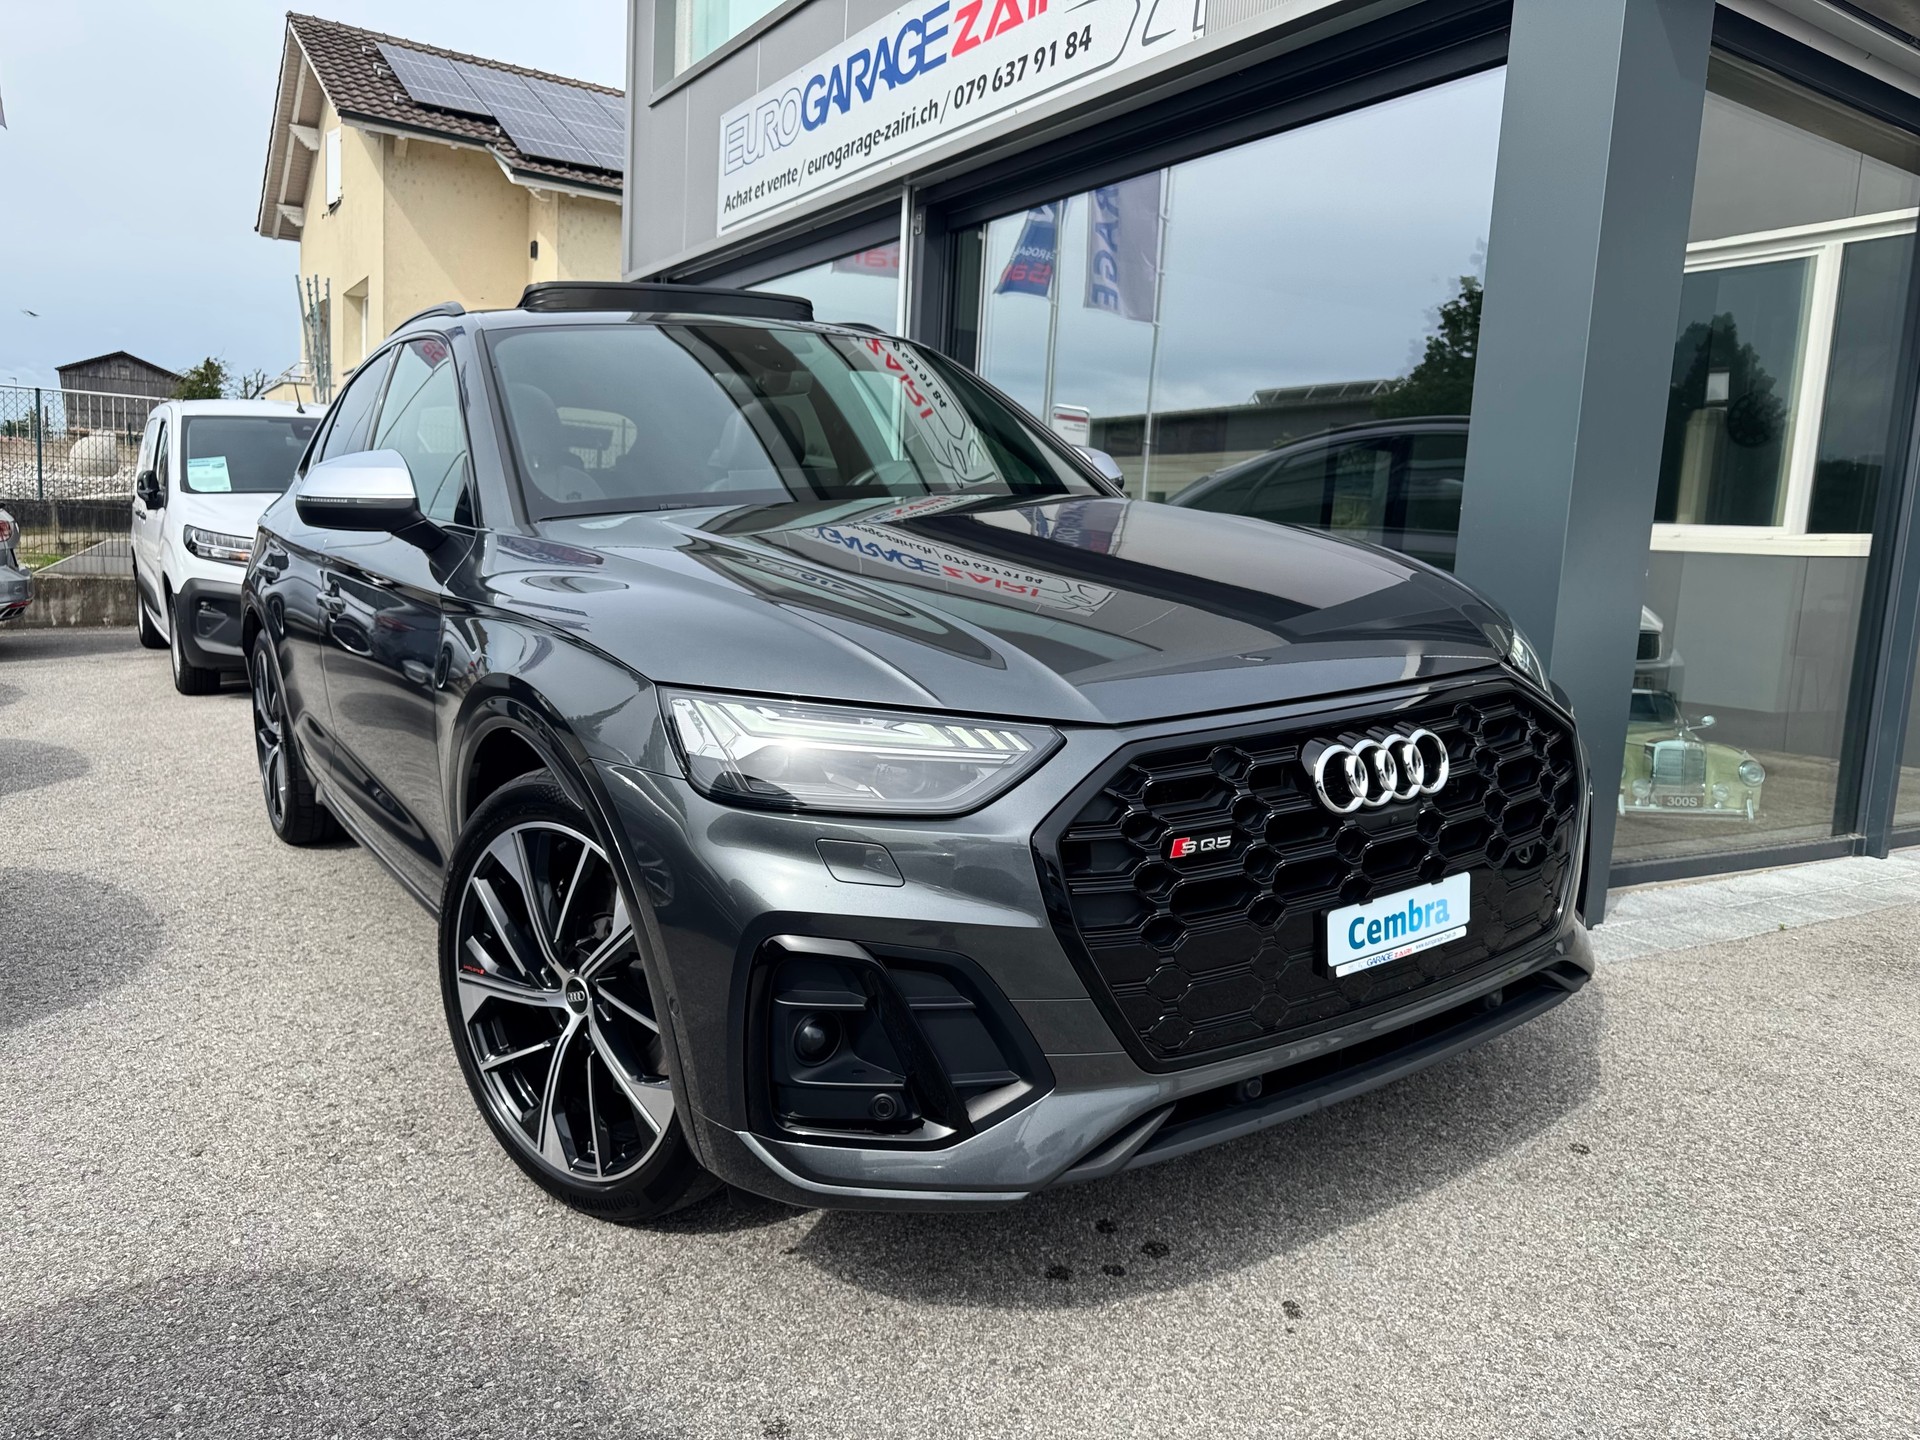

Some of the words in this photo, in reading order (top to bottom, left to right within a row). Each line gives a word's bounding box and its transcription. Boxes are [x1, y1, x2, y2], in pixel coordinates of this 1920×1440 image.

[724, 187, 752, 214] Achat
[754, 180, 765, 199] et
[767, 168, 798, 191] vente
[808, 98, 939, 175] eurogarage-zairi.ch
[954, 74, 987, 109] 079
[992, 54, 1028, 92] 637
[1034, 40, 1057, 74] 91
[1065, 24, 1092, 59] 84
[1667, 796, 1698, 807] 300S
[1348, 898, 1450, 950] Cembra
[1366, 951, 1394, 967] GARAGE
